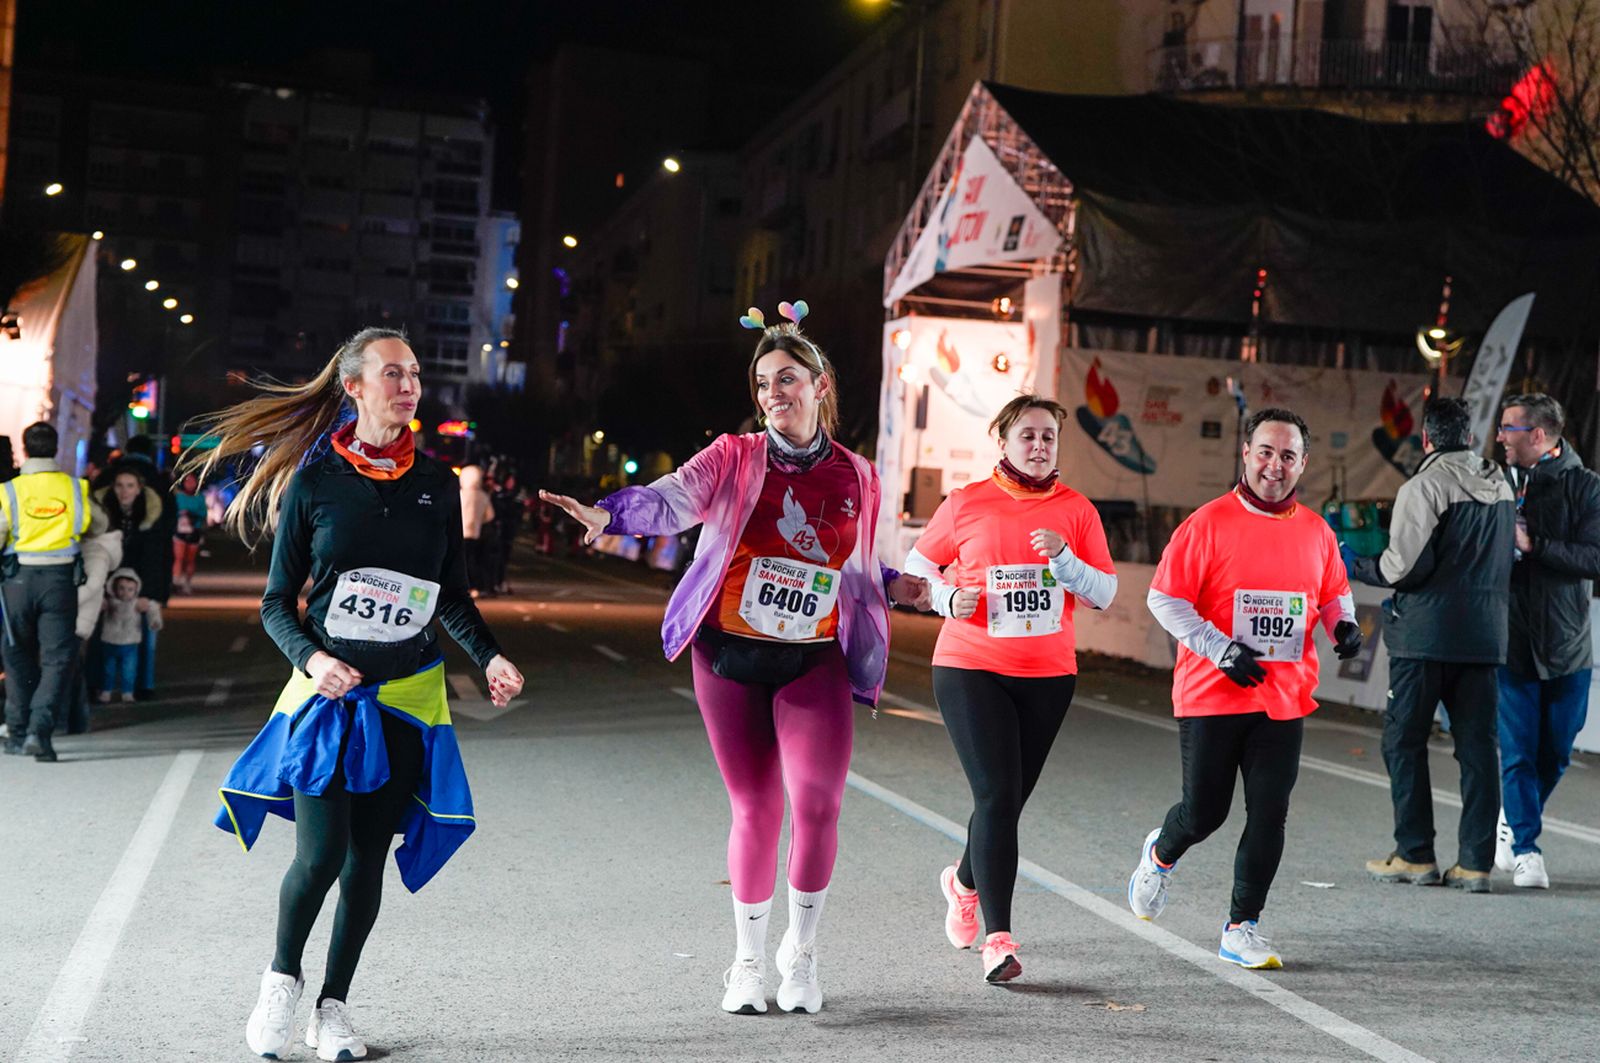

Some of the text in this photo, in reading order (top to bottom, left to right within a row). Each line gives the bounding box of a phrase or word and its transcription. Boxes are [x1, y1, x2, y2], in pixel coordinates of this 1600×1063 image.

[792, 530, 816, 550] 43
[758, 570, 776, 582] SAN
[770, 564, 796, 577] NOCHE
[797, 570, 808, 579] DE
[1004, 572, 1028, 580] NOCHE
[1028, 571, 1036, 579] DE
[360, 576, 389, 590] NOCHE
[390, 583, 402, 594] DE
[996, 582, 1012, 590] SAN
[758, 582, 818, 617] 6406
[1003, 589, 1051, 612] 1993
[1251, 598, 1273, 606] NOCHE
[338, 594, 413, 626] 4316
[1249, 616, 1294, 637] 1992
